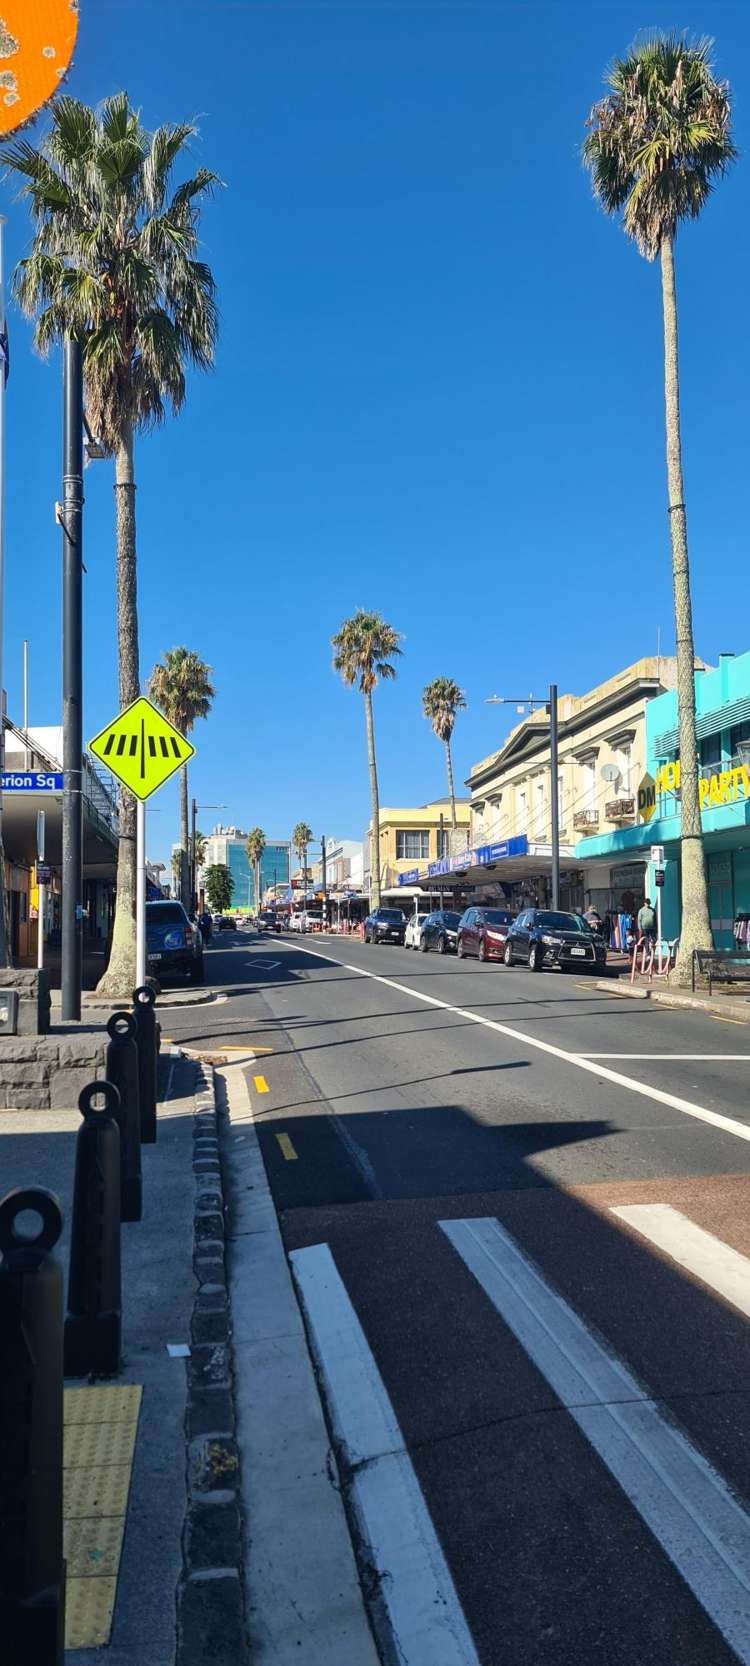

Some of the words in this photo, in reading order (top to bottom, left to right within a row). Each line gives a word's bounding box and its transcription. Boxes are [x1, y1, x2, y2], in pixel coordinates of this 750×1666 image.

[36, 774, 55, 789] Sq
[698, 765, 749, 811] PARTY
[638, 785, 656, 810] DM
